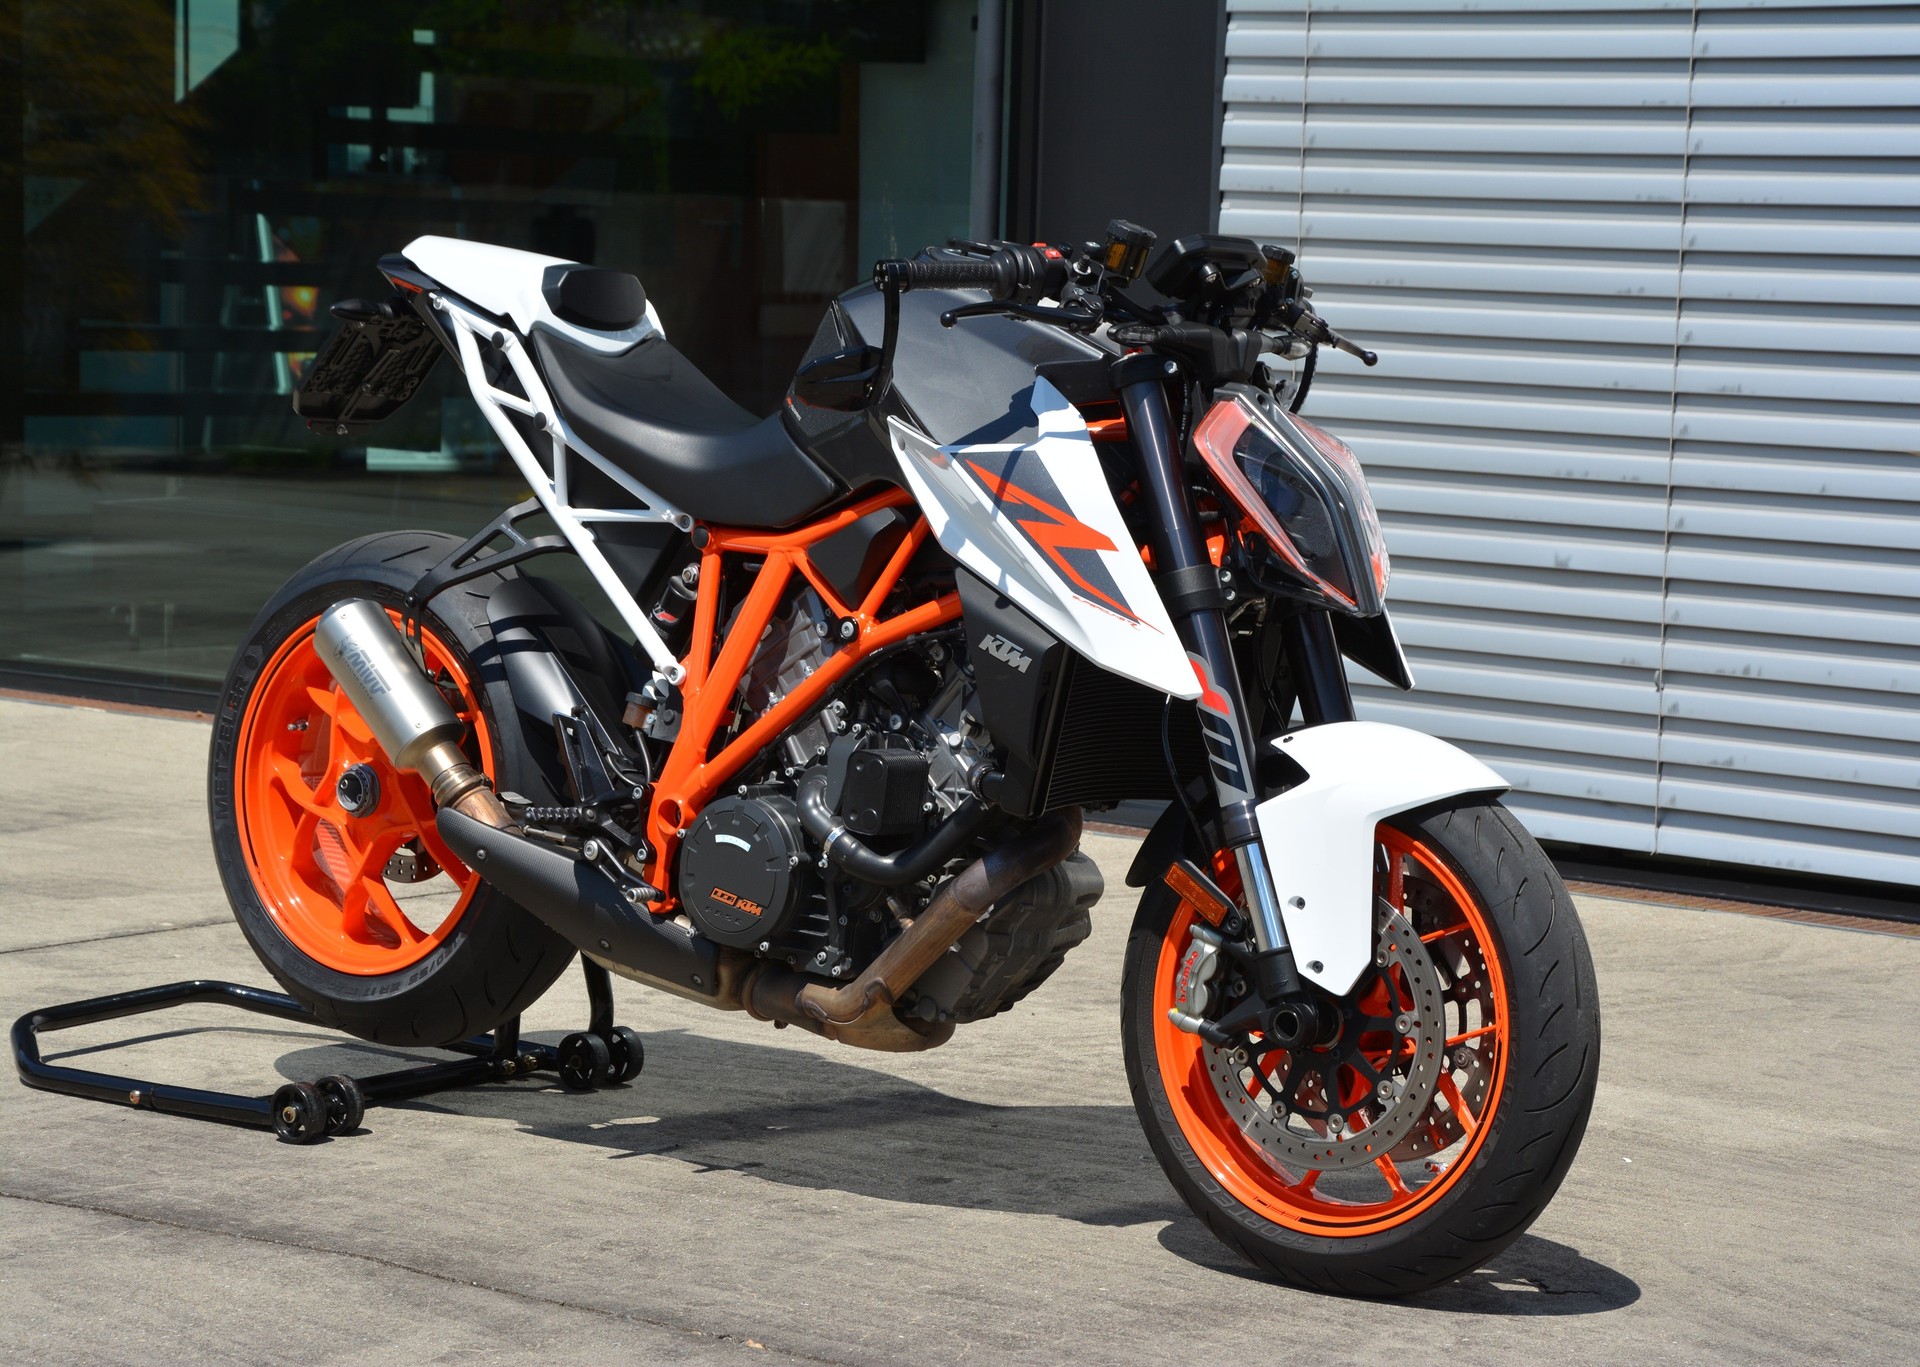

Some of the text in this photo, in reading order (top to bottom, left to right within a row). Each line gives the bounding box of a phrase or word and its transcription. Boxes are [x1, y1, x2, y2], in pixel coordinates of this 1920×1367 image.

[978, 634, 1033, 674] KTM
[214, 673, 250, 820] METZELER
[735, 898, 764, 917] KTM
[1178, 950, 1199, 1003] brembo
[1200, 1178, 1312, 1250] SPORTEC
